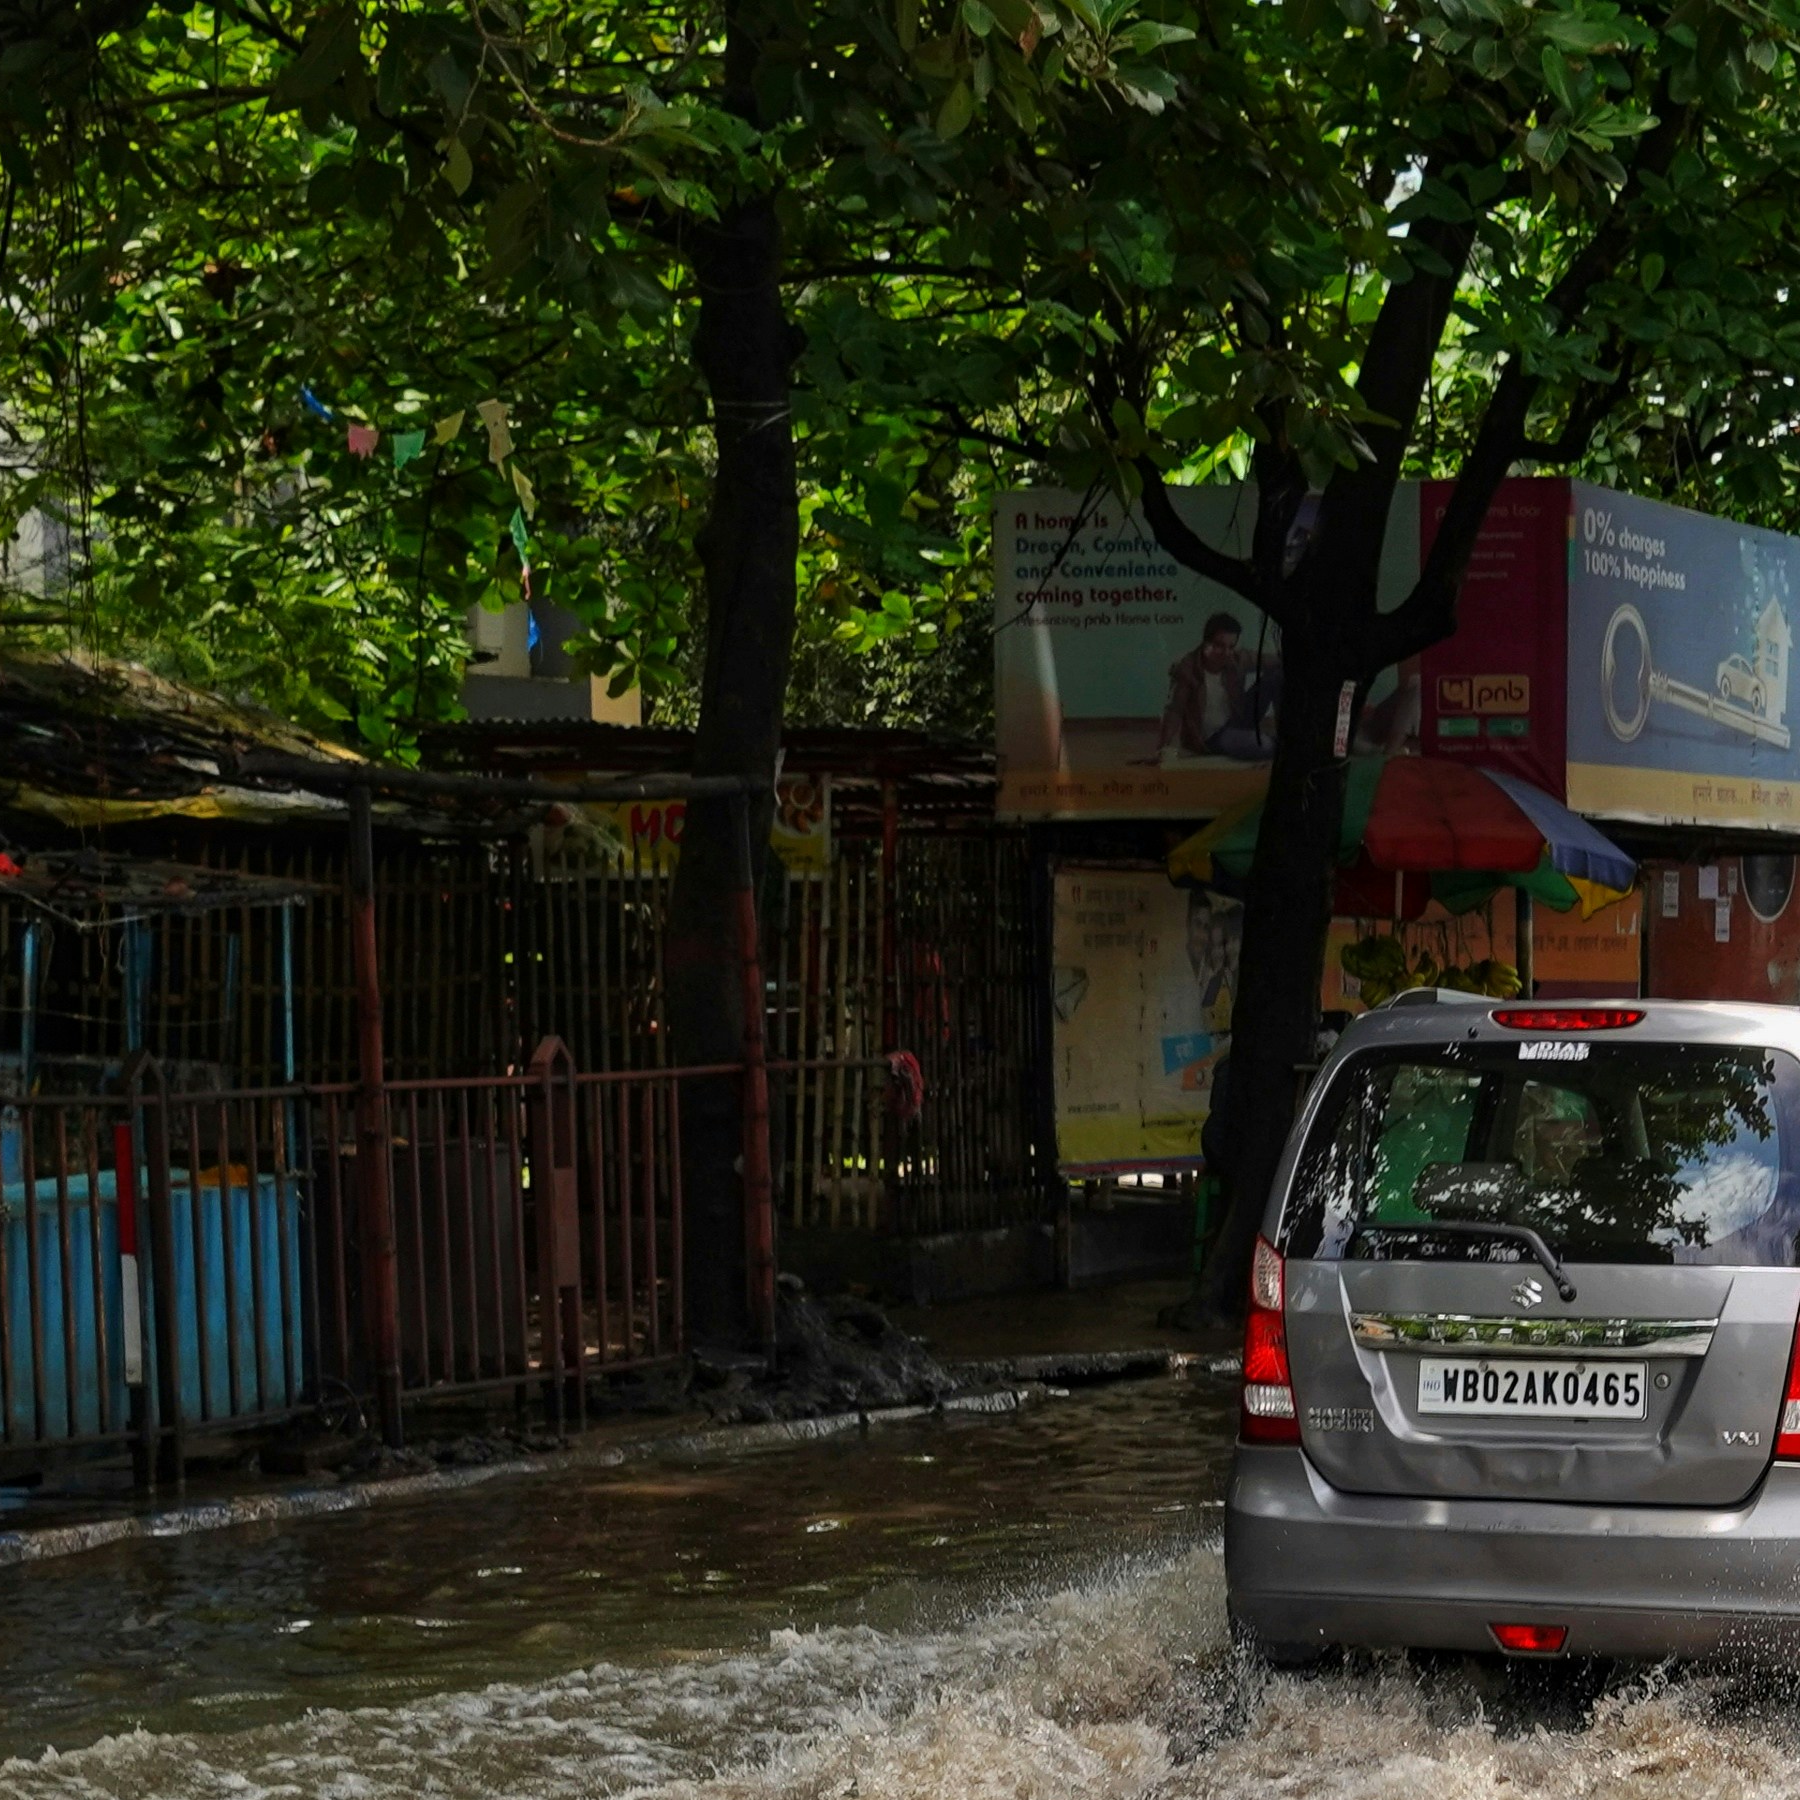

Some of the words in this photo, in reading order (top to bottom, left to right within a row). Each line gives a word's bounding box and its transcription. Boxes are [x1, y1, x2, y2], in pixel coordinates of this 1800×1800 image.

[1016, 513, 1027, 529] A
[1095, 513, 1108, 528] is
[1583, 506, 1615, 547] 0%
[1619, 527, 1666, 560] charges
[1094, 536, 1163, 554] Comfor
[1060, 560, 1178, 578] Convenience
[1584, 548, 1620, 579] 100%
[1623, 557, 1686, 591] happiness
[1016, 587, 1083, 607] coming
[1090, 585, 1177, 604] together.
[1478, 679, 1524, 708] pnb
[630, 803, 686, 848] MO
[1443, 1368, 1640, 1407] WB02AK0465
